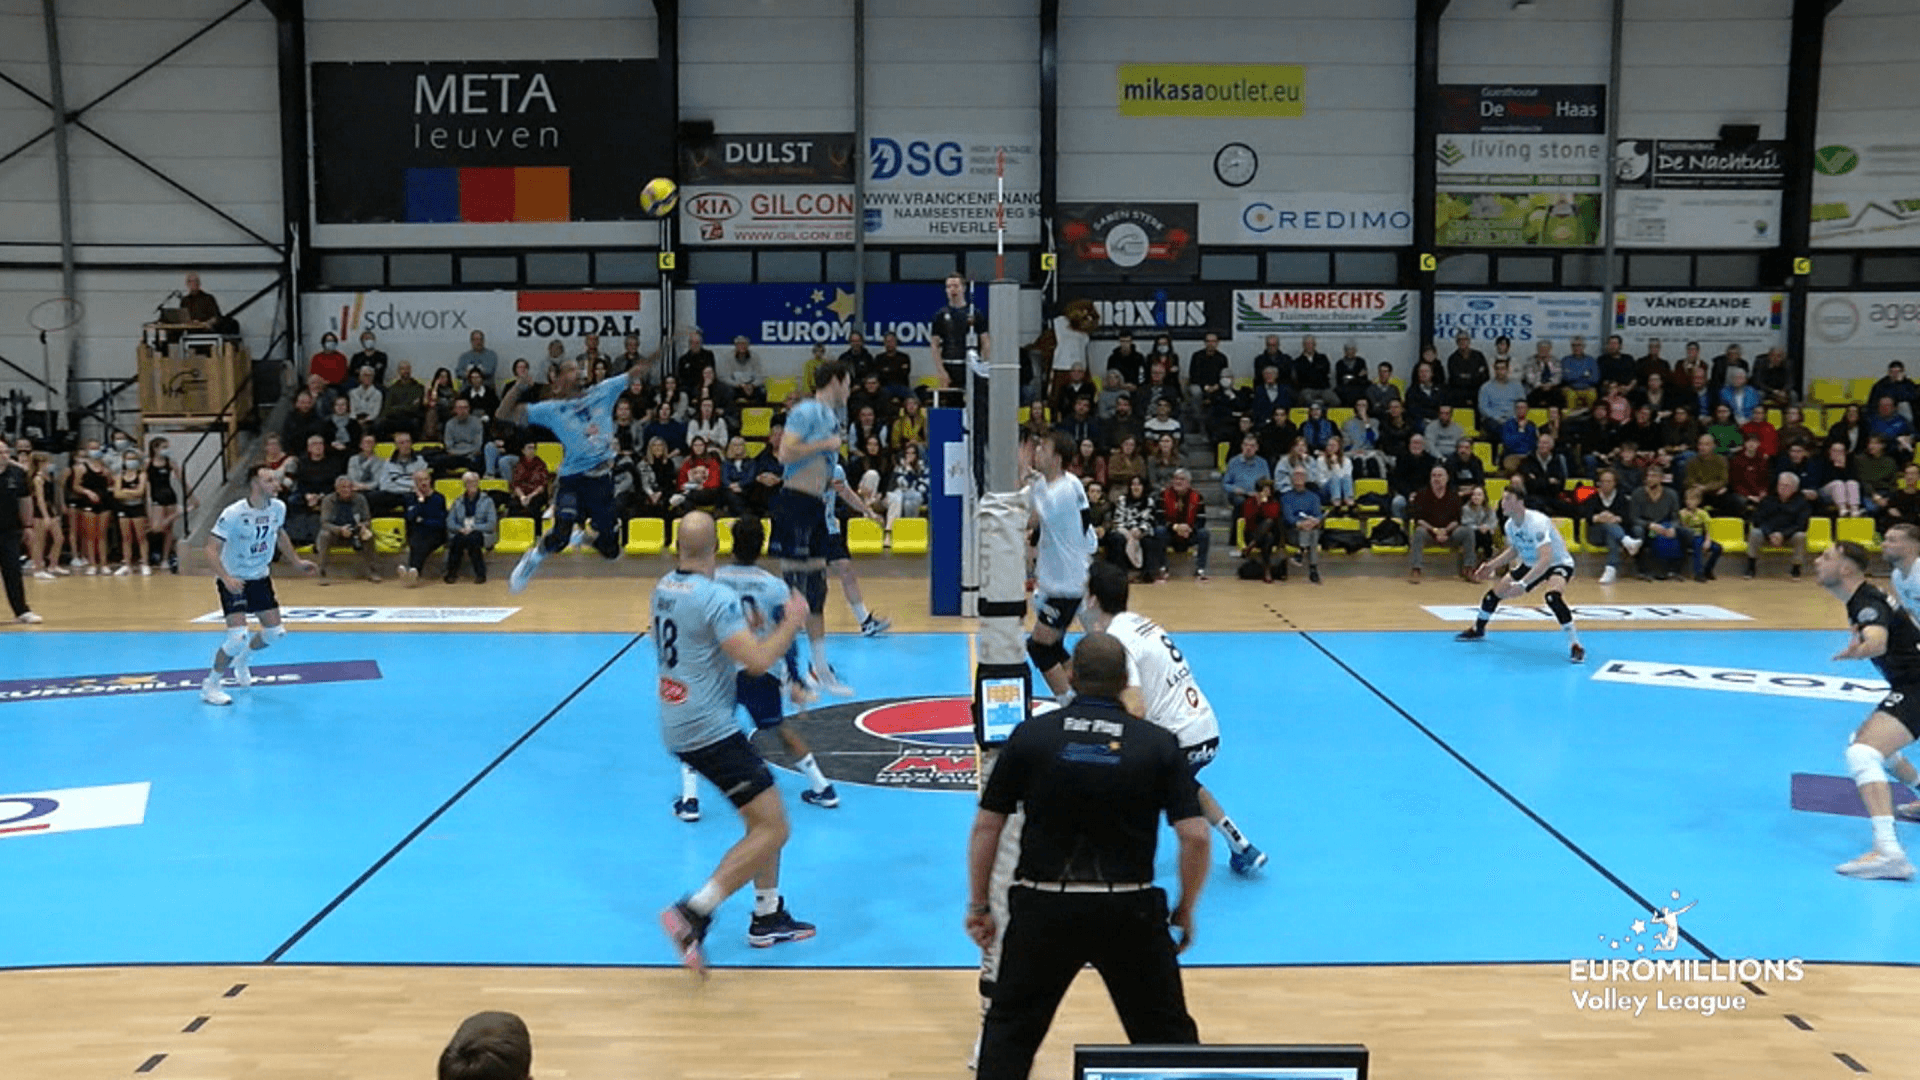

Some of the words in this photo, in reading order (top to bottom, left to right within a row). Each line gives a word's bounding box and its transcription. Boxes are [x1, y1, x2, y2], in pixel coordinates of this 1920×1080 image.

[414, 73, 558, 114] META
[1124, 77, 1300, 101] mikasaoutlet.eu
[1481, 102, 1505, 117] De
[1556, 101, 1598, 117] Haas
[414, 123, 559, 148] leuven
[725, 142, 814, 163] DULST
[870, 137, 963, 180] DSG
[1471, 139, 1531, 162] living
[1539, 142, 1600, 159] stone
[1658, 154, 1684, 171] De
[1688, 149, 1780, 170] Nachtuil
[696, 199, 732, 214] KIA
[751, 193, 854, 215] GILCON
[1243, 202, 1412, 233] CREDIMO
[1259, 292, 1386, 309] LAMBRECHTS
[1645, 298, 1750, 308] VANDEZANDE
[516, 315, 641, 338] SOUDAL
[1627, 316, 1740, 327] BOUWBEDRIJF
[1745, 316, 1769, 327] NV
[256, 525, 269, 540] 17
[655, 615, 678, 668] 18
[1160, 634, 1183, 662] 8
